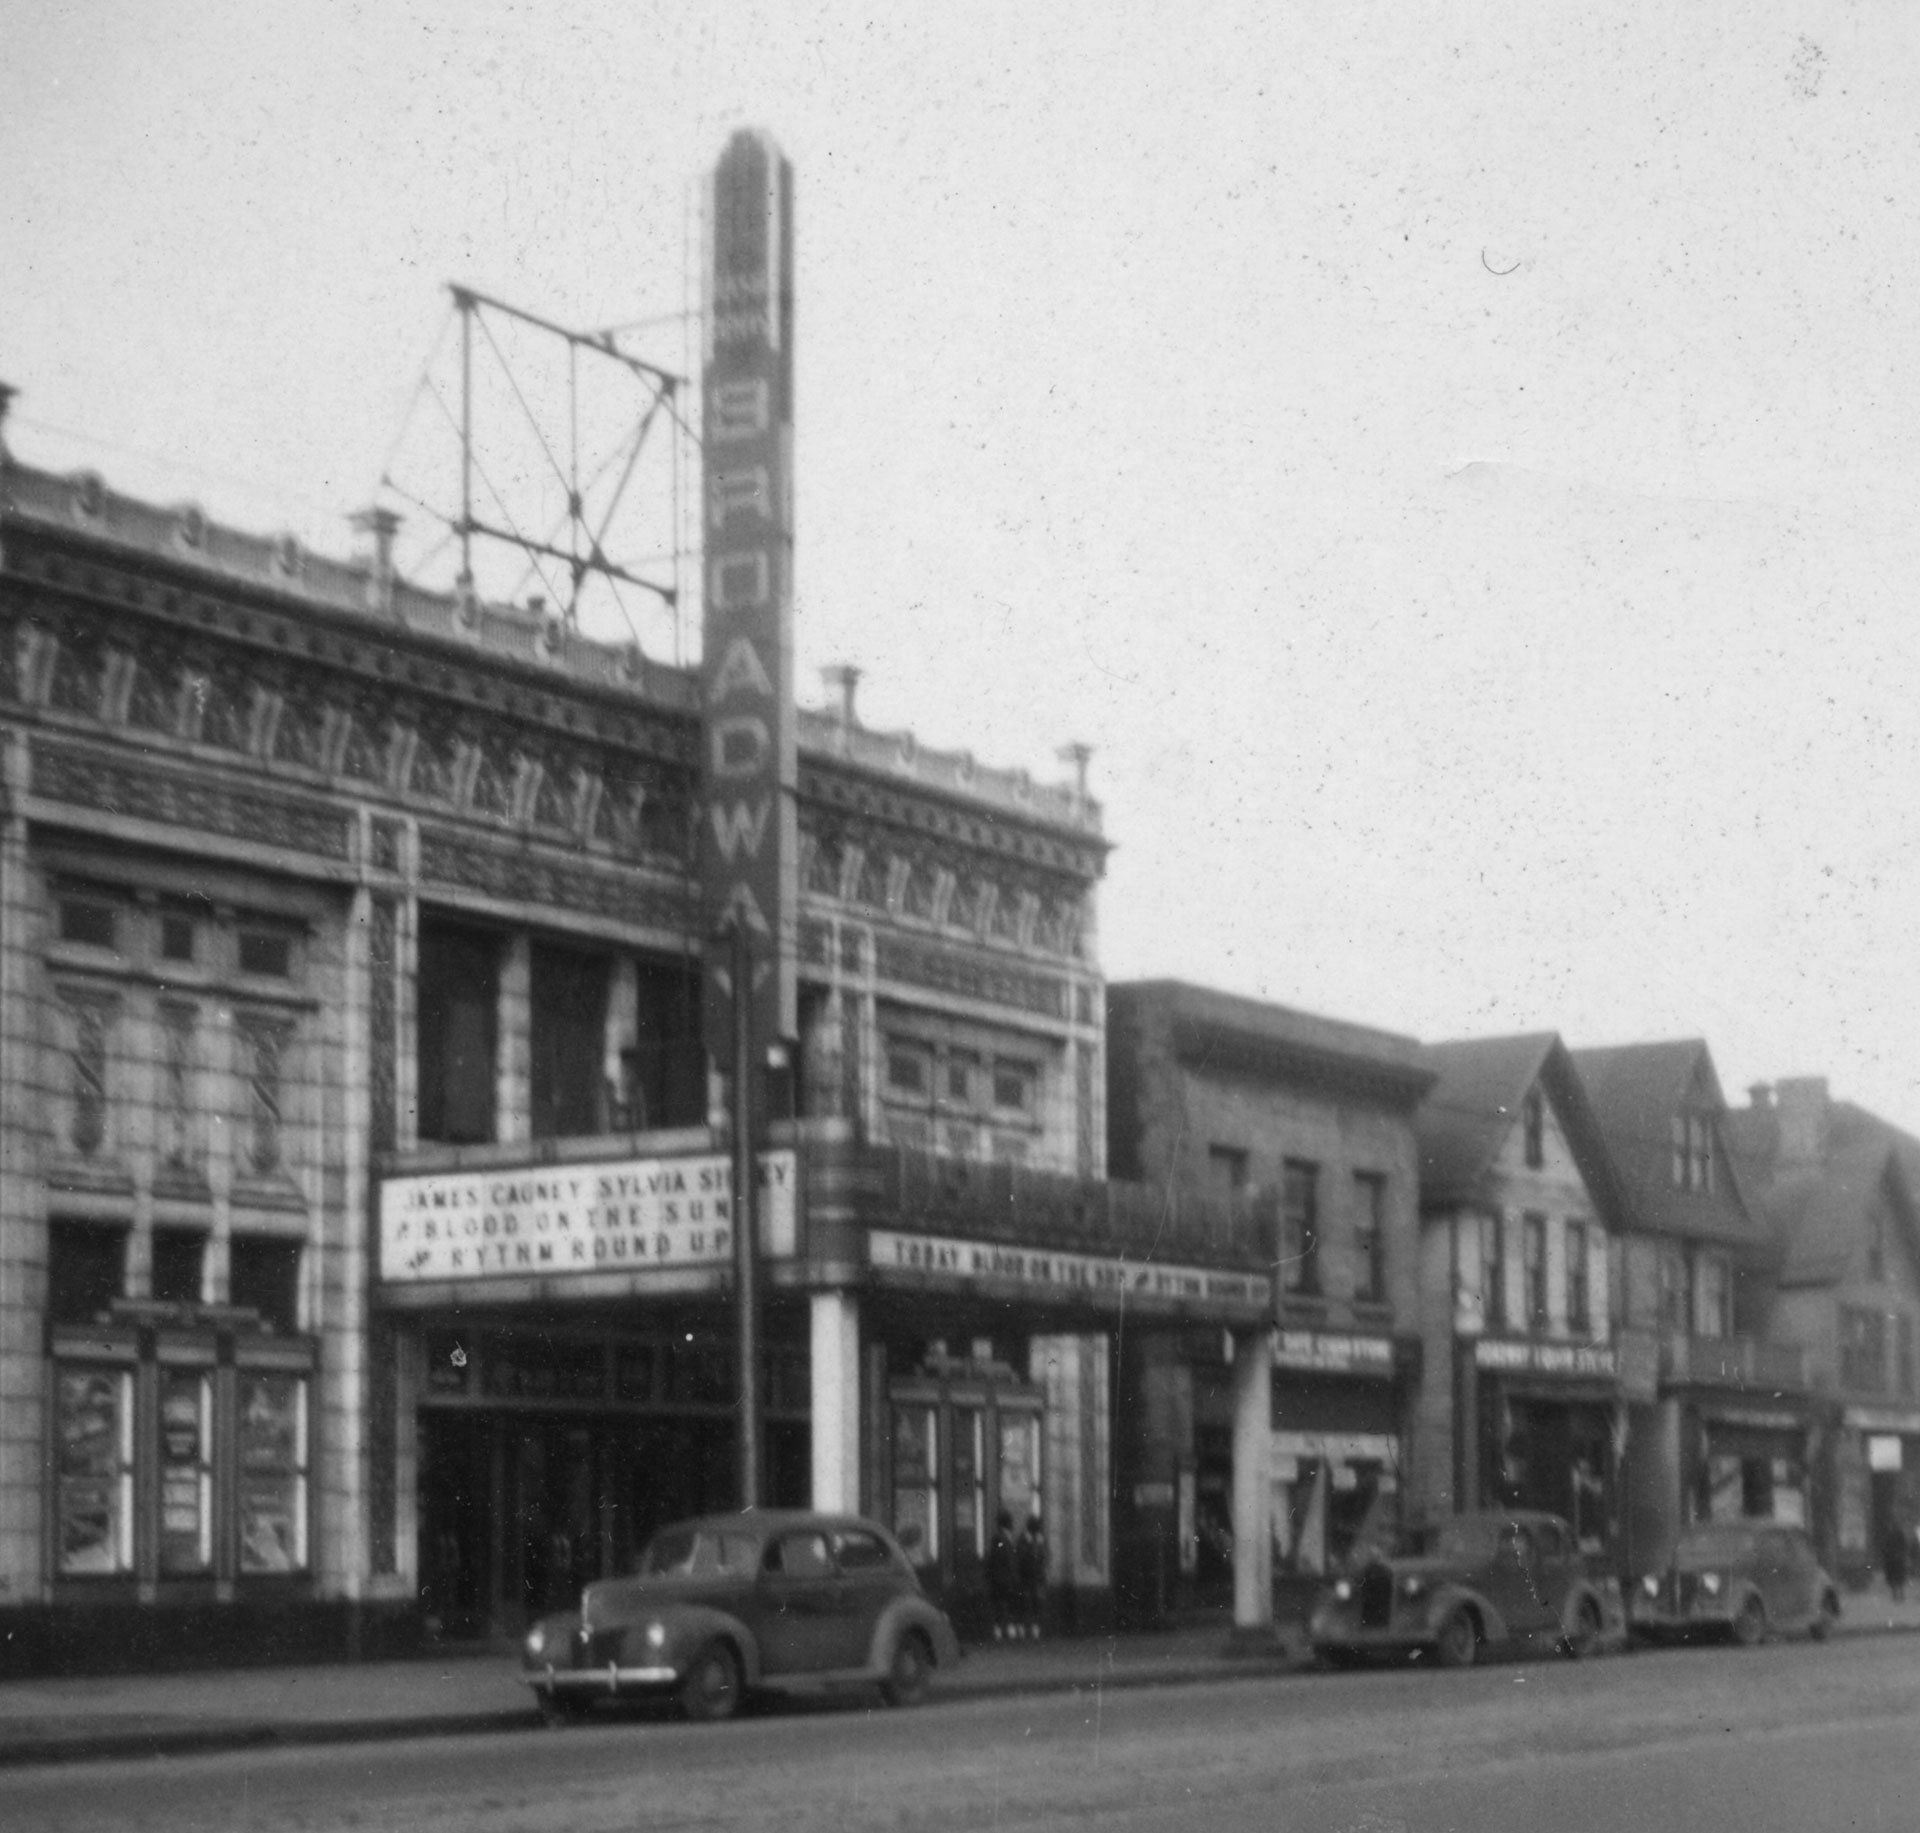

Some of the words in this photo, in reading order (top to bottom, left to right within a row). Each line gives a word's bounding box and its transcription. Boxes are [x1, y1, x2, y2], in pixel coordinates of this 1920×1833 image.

[711, 374, 773, 1002] BROADWAY
[406, 1187, 478, 1211] JAMES
[491, 1179, 579, 1206] CAGNEY
[599, 1171, 686, 1198] SYLVIA
[424, 1212, 519, 1240] BLOOD
[535, 1211, 570, 1232] ON
[586, 1204, 640, 1230] THE
[665, 1200, 730, 1226] SUN
[571, 1231, 671, 1262] ROUND
[689, 1227, 730, 1253] UP
